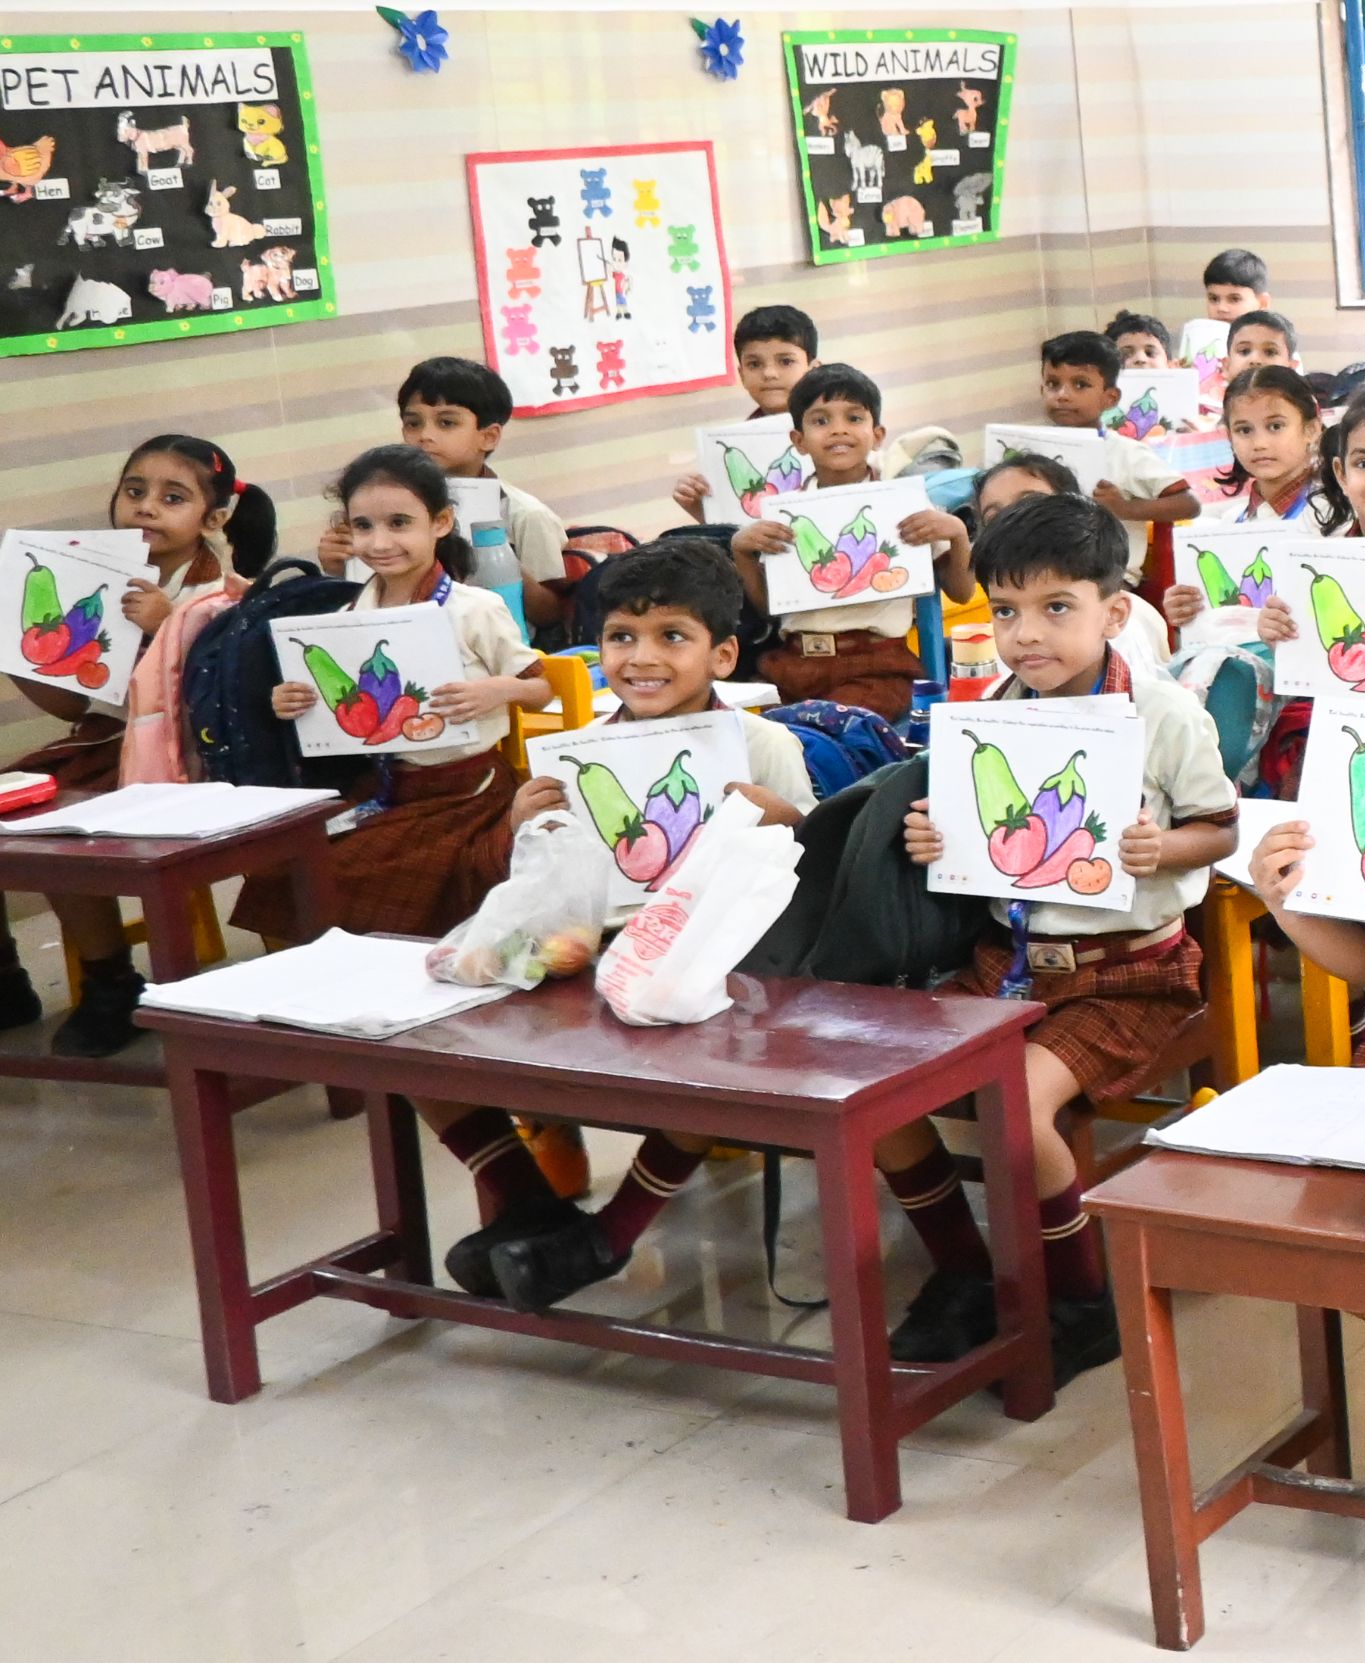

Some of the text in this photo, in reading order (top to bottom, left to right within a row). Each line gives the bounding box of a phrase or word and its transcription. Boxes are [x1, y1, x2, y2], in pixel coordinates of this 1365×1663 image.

[805, 48, 997, 78] WILD ANIMALS
[0, 62, 275, 105] PET ANIMALS
[150, 174, 178, 186] Goat
[37, 185, 63, 197] Hen
[266, 221, 300, 235] Rabbit
[137, 235, 161, 246] Cow
[295, 276, 314, 290] Dog
[213, 294, 229, 306] Pig
